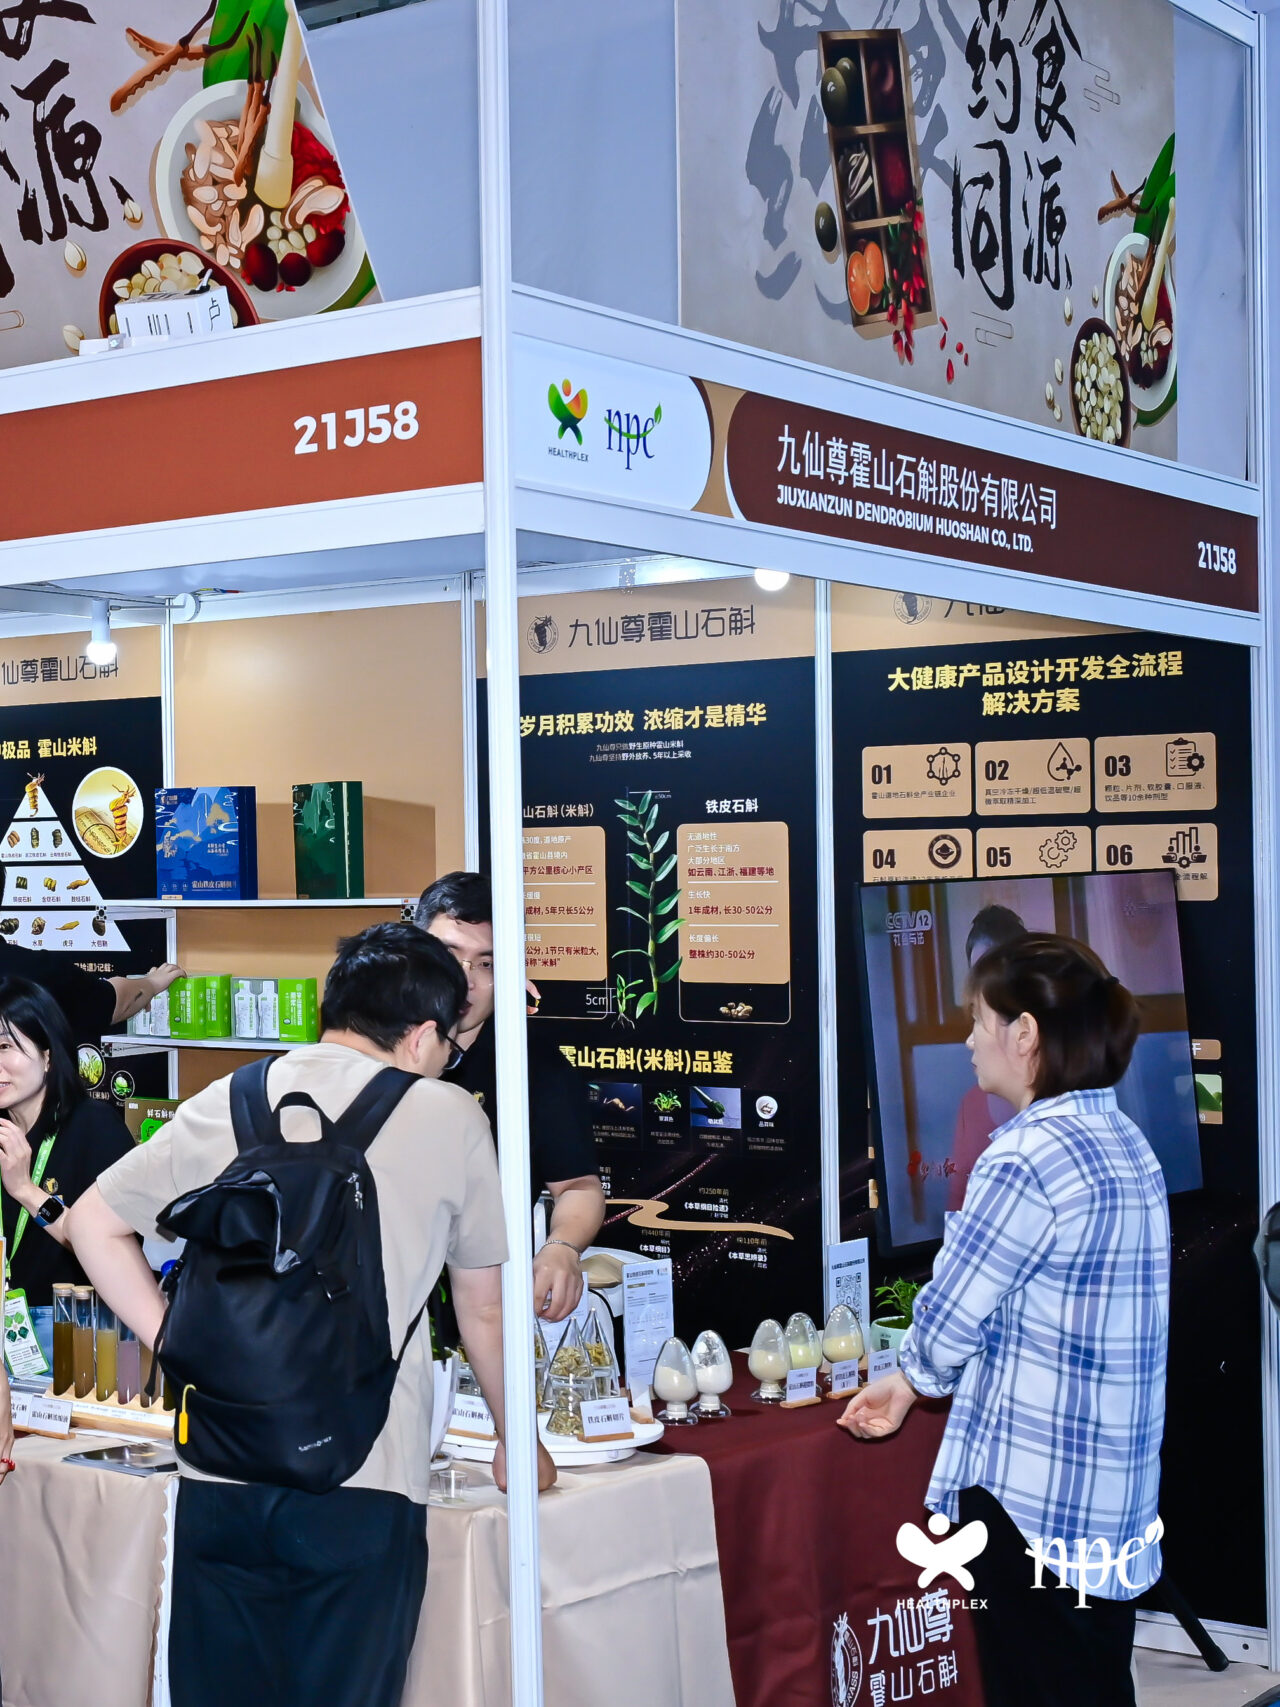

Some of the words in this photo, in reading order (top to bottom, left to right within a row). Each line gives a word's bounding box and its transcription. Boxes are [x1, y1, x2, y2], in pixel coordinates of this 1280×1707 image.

[294, 400, 420, 457] 21J58
[605, 405, 662, 471] npc
[547, 446, 589, 464] HEALTHPLEX
[776, 422, 1058, 531] 九仙尊霍山石斛股份有限公司
[776, 485, 854, 516] JIUXIANZUN
[855, 499, 934, 531] DENDROBIUM
[935, 514, 990, 542] HUOSHAN
[991, 527, 1011, 548] CO.,
[1011, 532, 1035, 554] LTD.
[1197, 540, 1237, 577] 21J58
[568, 604, 756, 648] 九仙尊霍山石斛
[887, 650, 1183, 692] 大健康产品设计开发全流程
[981, 687, 1081, 716] 解决方案
[519, 710, 635, 738] 岁月积累功效
[643, 702, 767, 732] 浓缩才是精华
[37, 736, 97, 758] 霍山米斛
[871, 764, 892, 785] 01
[984, 759, 1010, 781] 02
[1104, 755, 1132, 778] 03
[705, 798, 759, 814] 铁皮石斛
[872, 848, 897, 869] 04
[986, 846, 1012, 868] 05
[1106, 844, 1133, 866] 06
[585, 994, 609, 1006] 5cm
[866, 1587, 954, 1665] 九仙尊
[869, 1649, 958, 1707] 霍山石斛
